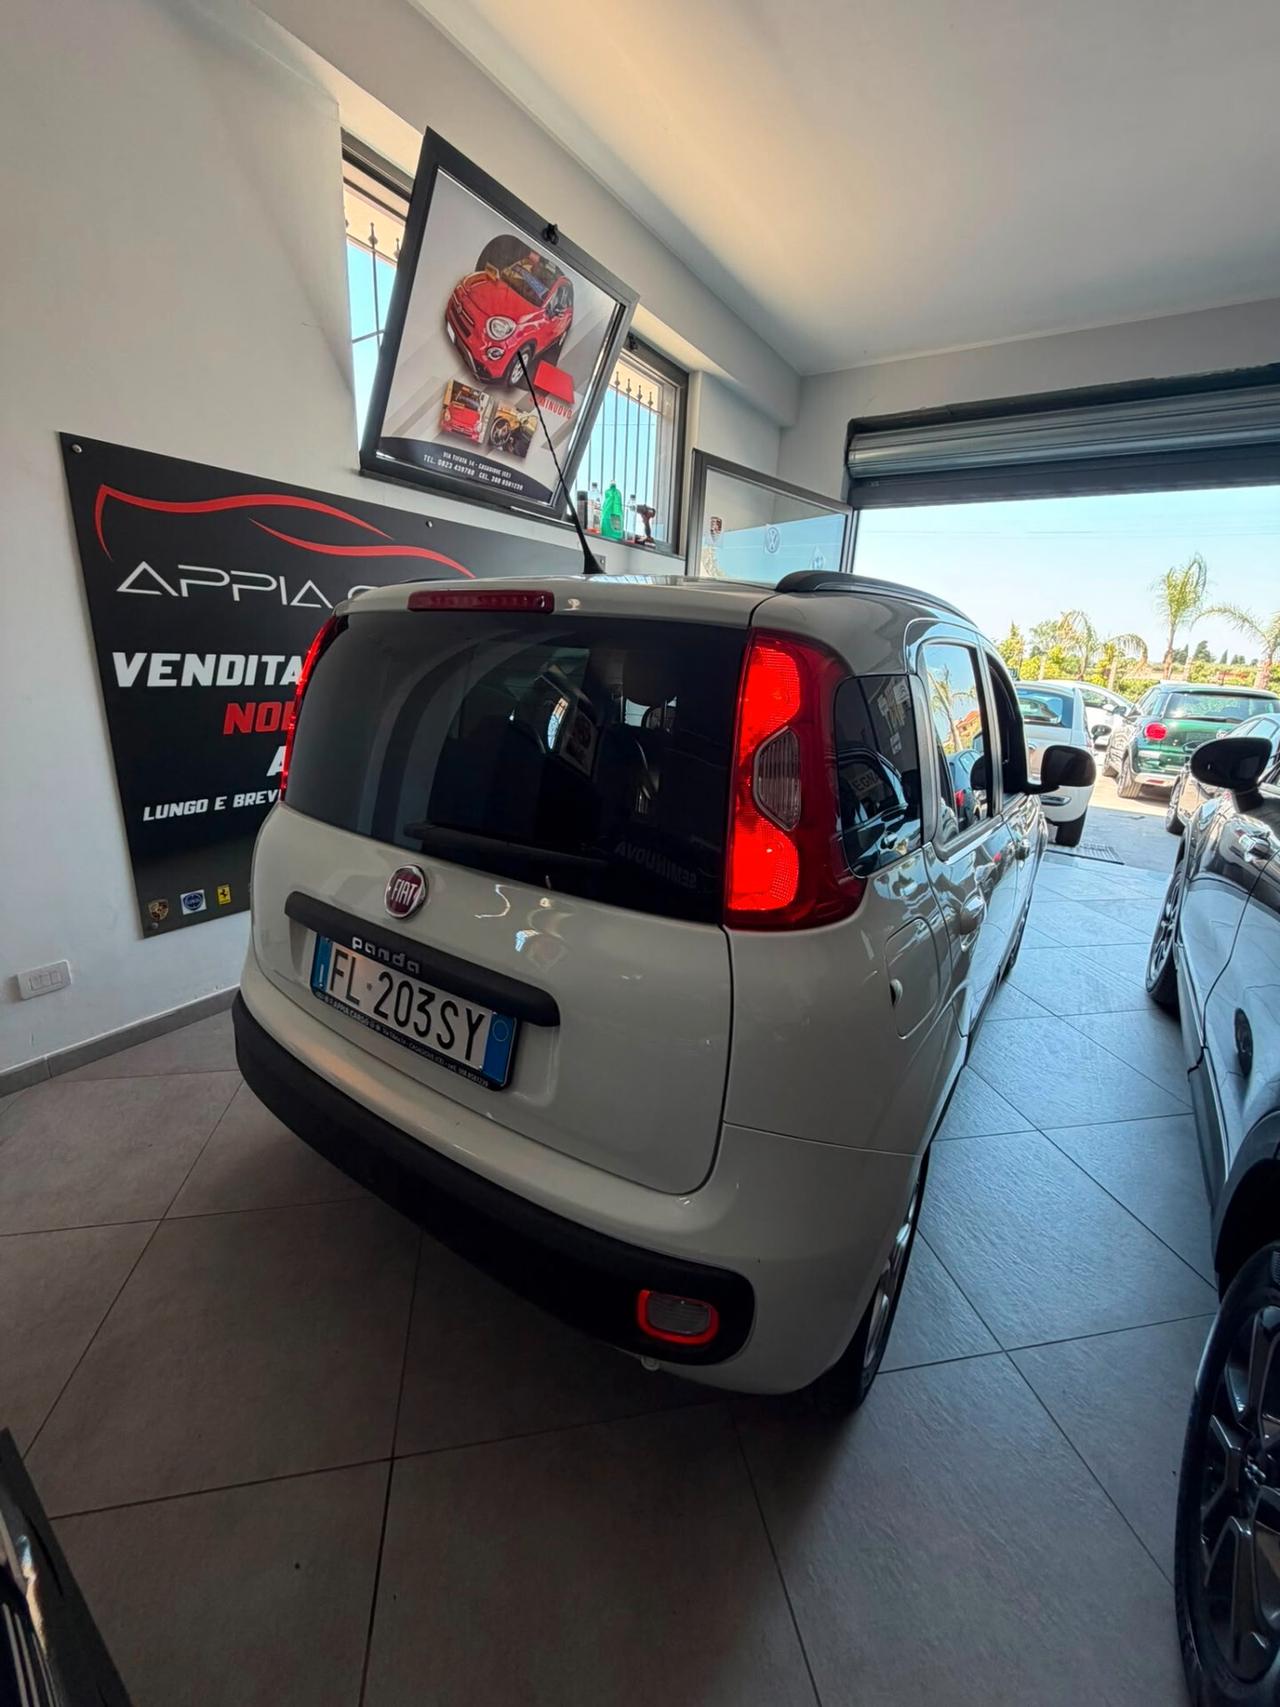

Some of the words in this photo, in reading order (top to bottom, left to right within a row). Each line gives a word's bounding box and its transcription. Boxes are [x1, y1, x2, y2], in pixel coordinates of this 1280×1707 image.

[423, 454, 436, 465] TEL.
[116, 560, 334, 609] APPIA
[112, 651, 303, 687] VENDITA
[143, 799, 209, 821] LUNGO
[214, 796, 228, 811] E
[233, 788, 282, 808] BREV
[391, 878, 418, 906] FIAT
